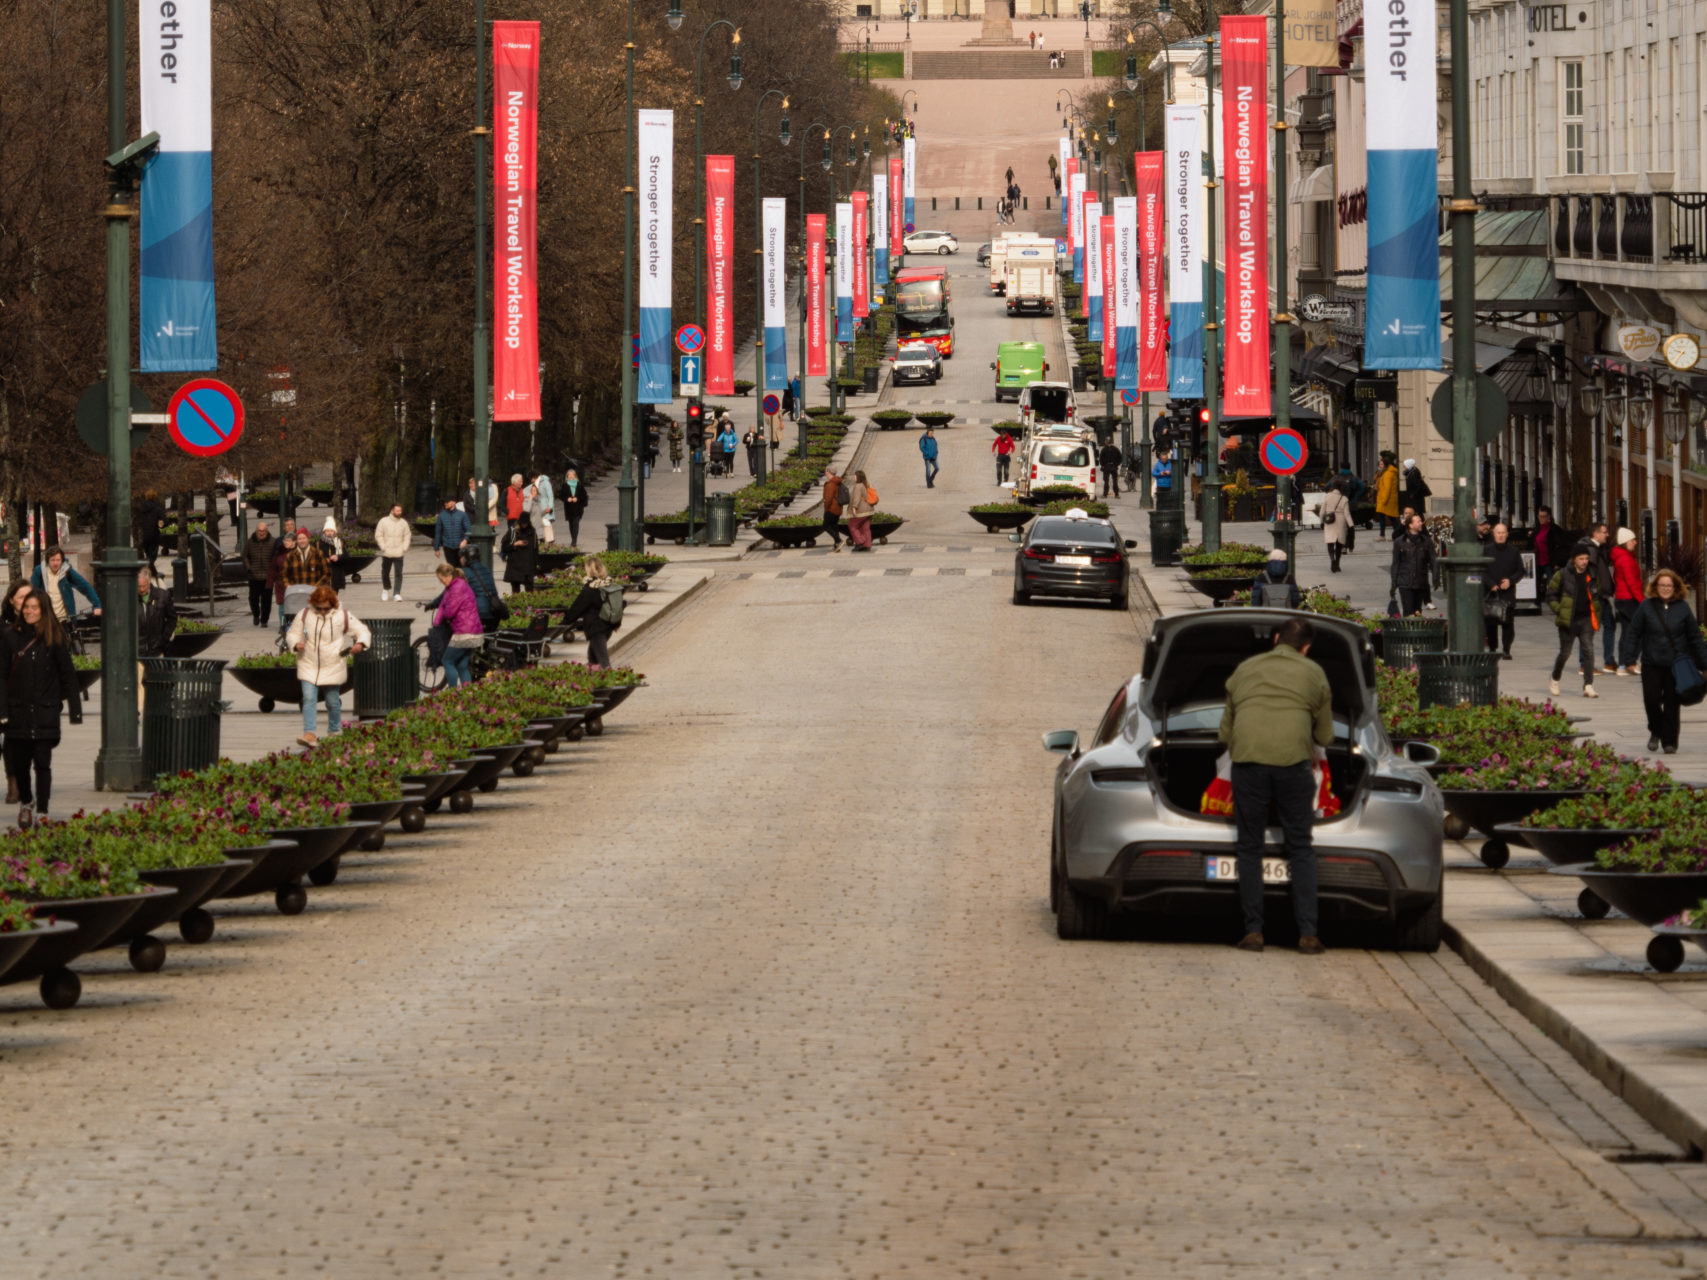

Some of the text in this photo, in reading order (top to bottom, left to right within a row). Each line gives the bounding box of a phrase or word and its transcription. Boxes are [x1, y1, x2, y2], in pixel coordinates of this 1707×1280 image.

[1528, 4, 1576, 32] HOTEL
[504, 91, 523, 349] Norwegian Travel Workshop
[647, 155, 660, 278] Stronger together
[768, 227, 777, 308] Stronger together
[1120, 227, 1130, 307] Stronger together
[1146, 193, 1158, 349] Norwegian Travel Workshop
[1177, 150, 1191, 273] Stronger together
[1236, 86, 1256, 344] Norwegian Travel Workshop
[713, 197, 726, 352] Norwegian Travel Workshop
[811, 242, 820, 348] Norwegian Travel Workshop
